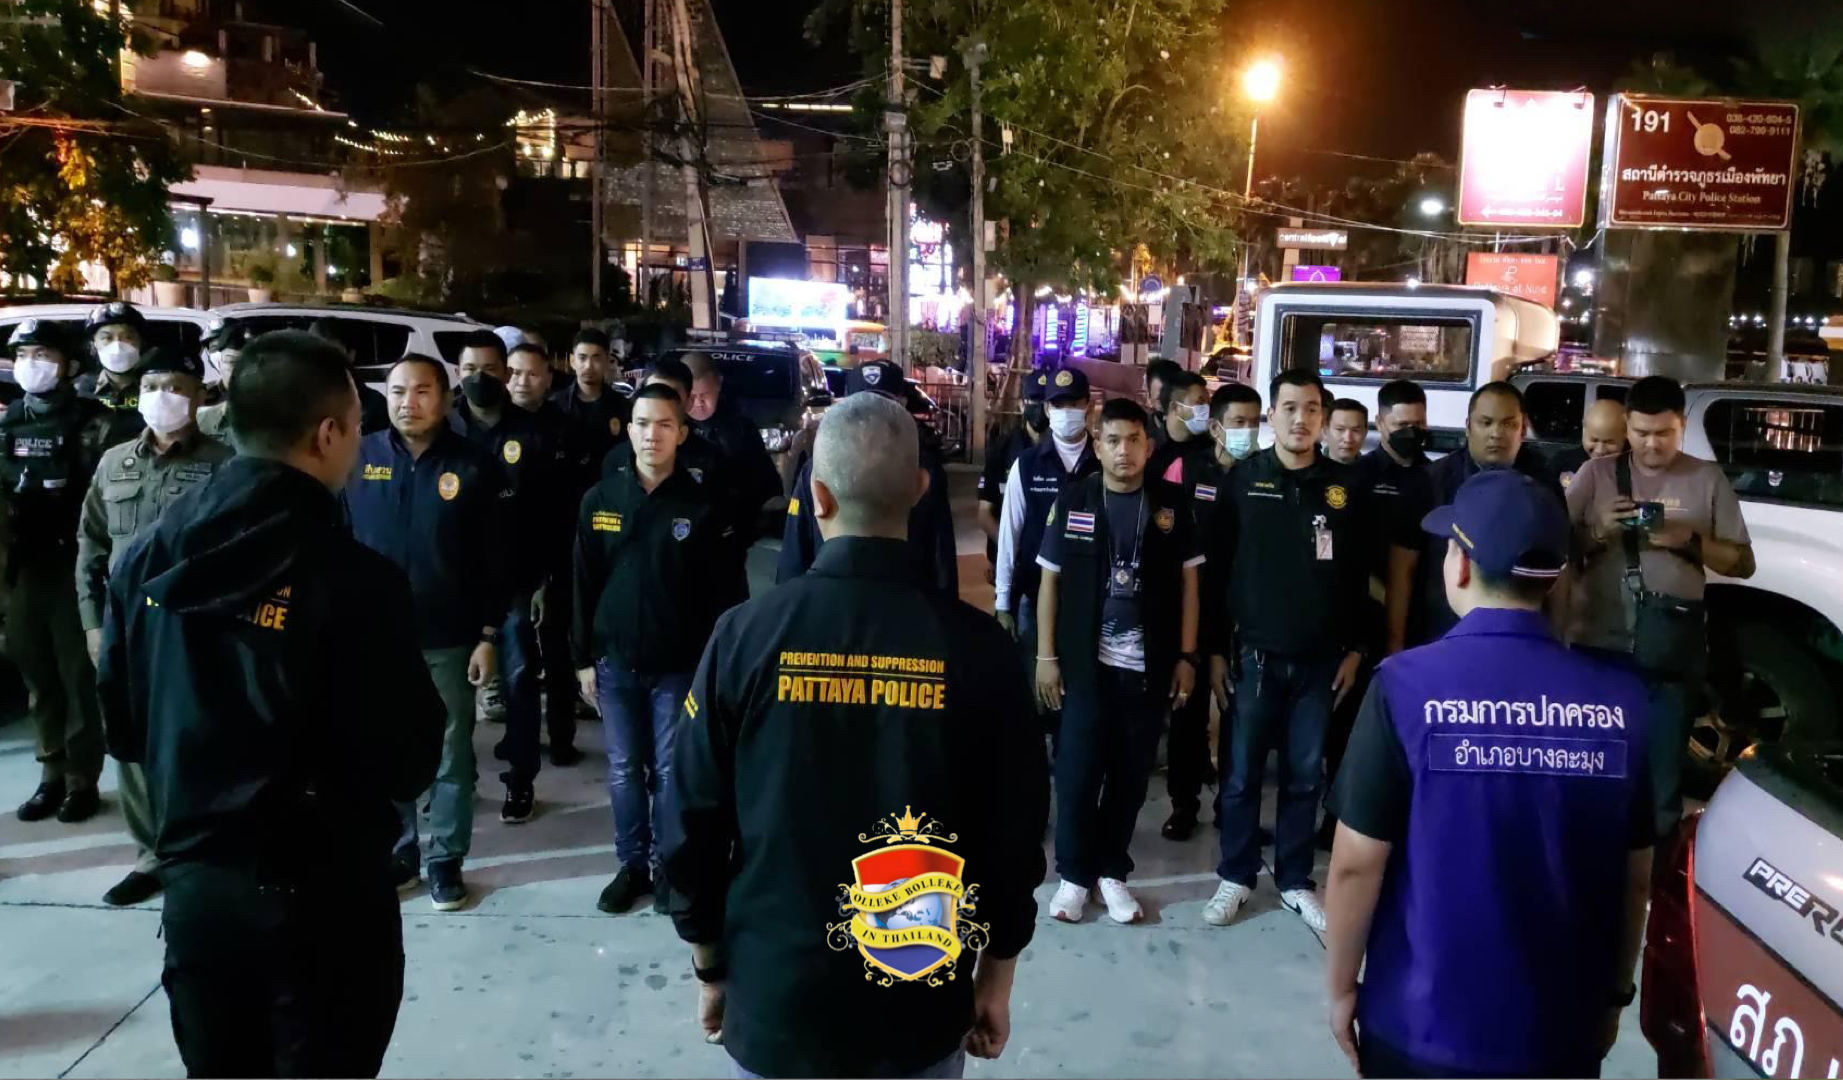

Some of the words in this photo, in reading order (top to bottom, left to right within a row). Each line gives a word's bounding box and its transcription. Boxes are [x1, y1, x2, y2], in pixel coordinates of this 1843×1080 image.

[1631, 110, 1670, 133] 191
[1642, 190, 1676, 203] Pattaya
[1678, 190, 1696, 204] City
[1700, 190, 1727, 203] Police
[1728, 193, 1761, 204] Station
[711, 352, 755, 362] OLICE
[780, 652, 845, 667] PREVENTION
[847, 654, 868, 668] AND
[871, 655, 944, 673] SUPPRESSION
[777, 675, 866, 704] PATTAYA
[871, 679, 946, 709] POLICE
[1424, 695, 1625, 729] กรมการปกครอง
[1455, 739, 1604, 774] อำเภอบางละมุง
